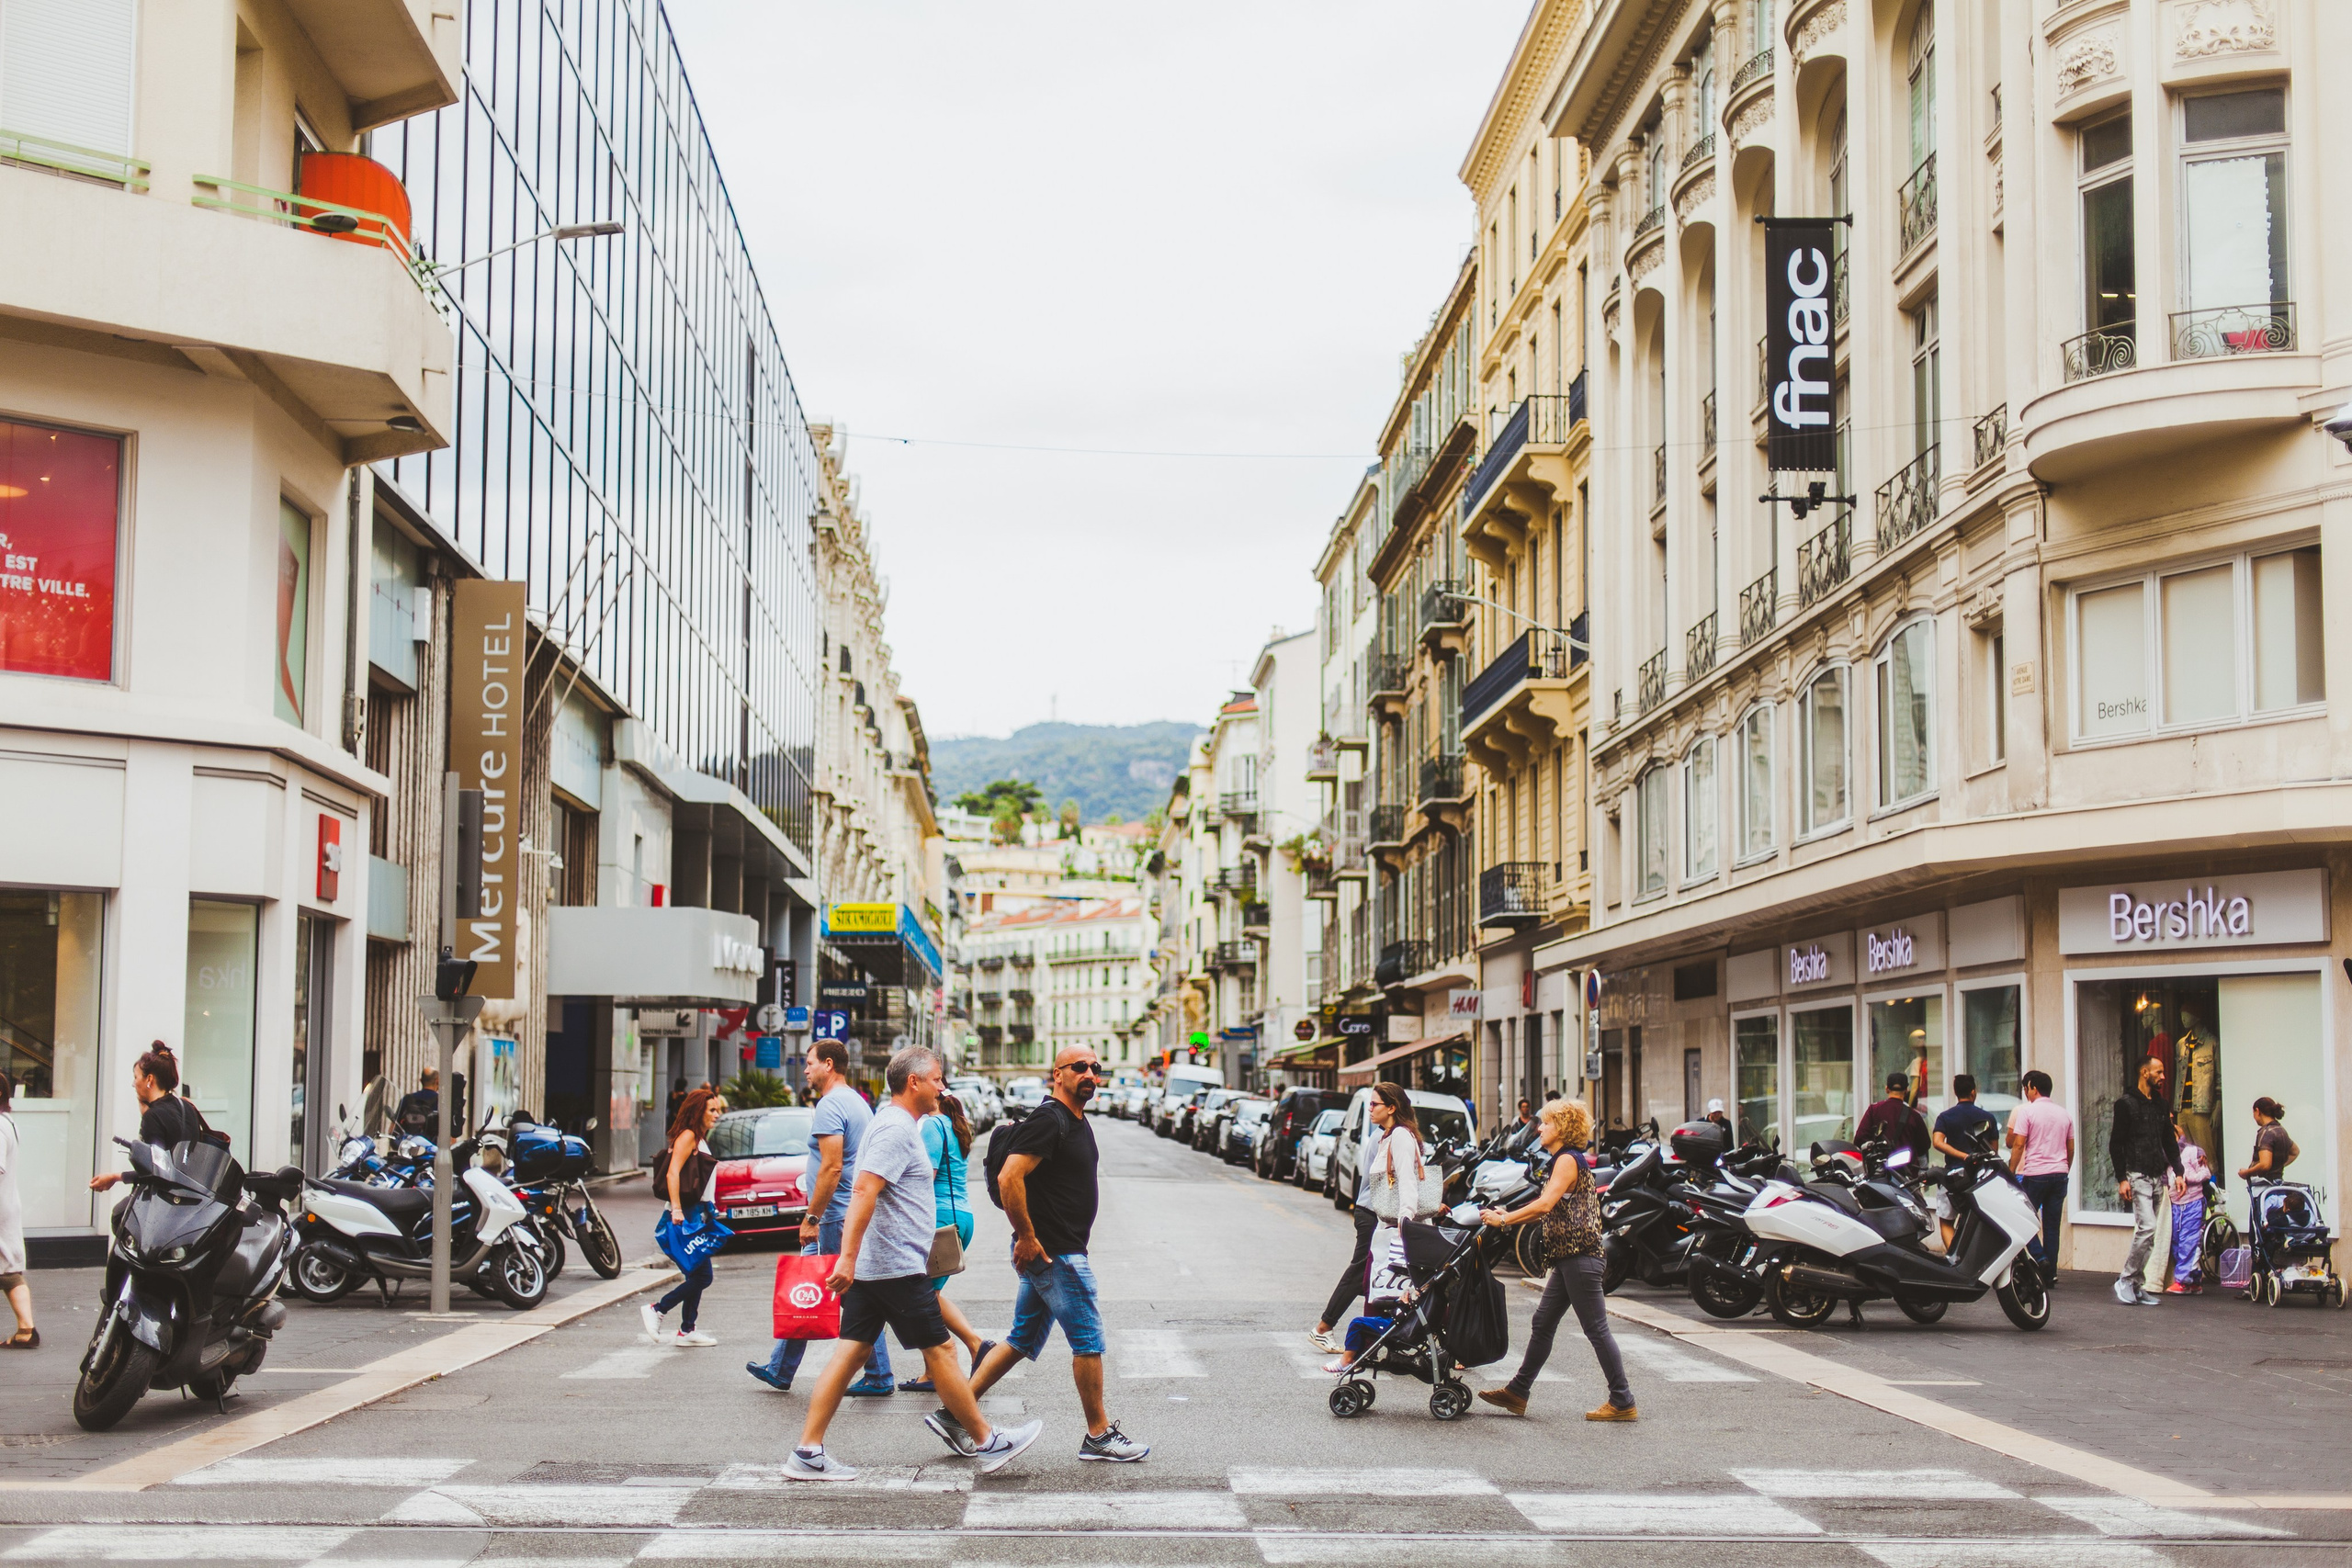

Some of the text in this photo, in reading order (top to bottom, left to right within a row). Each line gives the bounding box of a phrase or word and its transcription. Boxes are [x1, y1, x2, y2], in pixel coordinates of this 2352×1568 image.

[1773, 247, 1830, 430] fnac
[6, 554, 38, 571] EST
[38, 578, 90, 598] VILLE.
[2098, 696, 2147, 719] Bershka
[469, 612, 511, 964] Mercure HOTEL
[2109, 886, 2251, 942] Bershka
[1791, 944, 1827, 984] Bershka
[1868, 928, 1913, 972] Bershka
[796, 1289, 818, 1302] C&A
